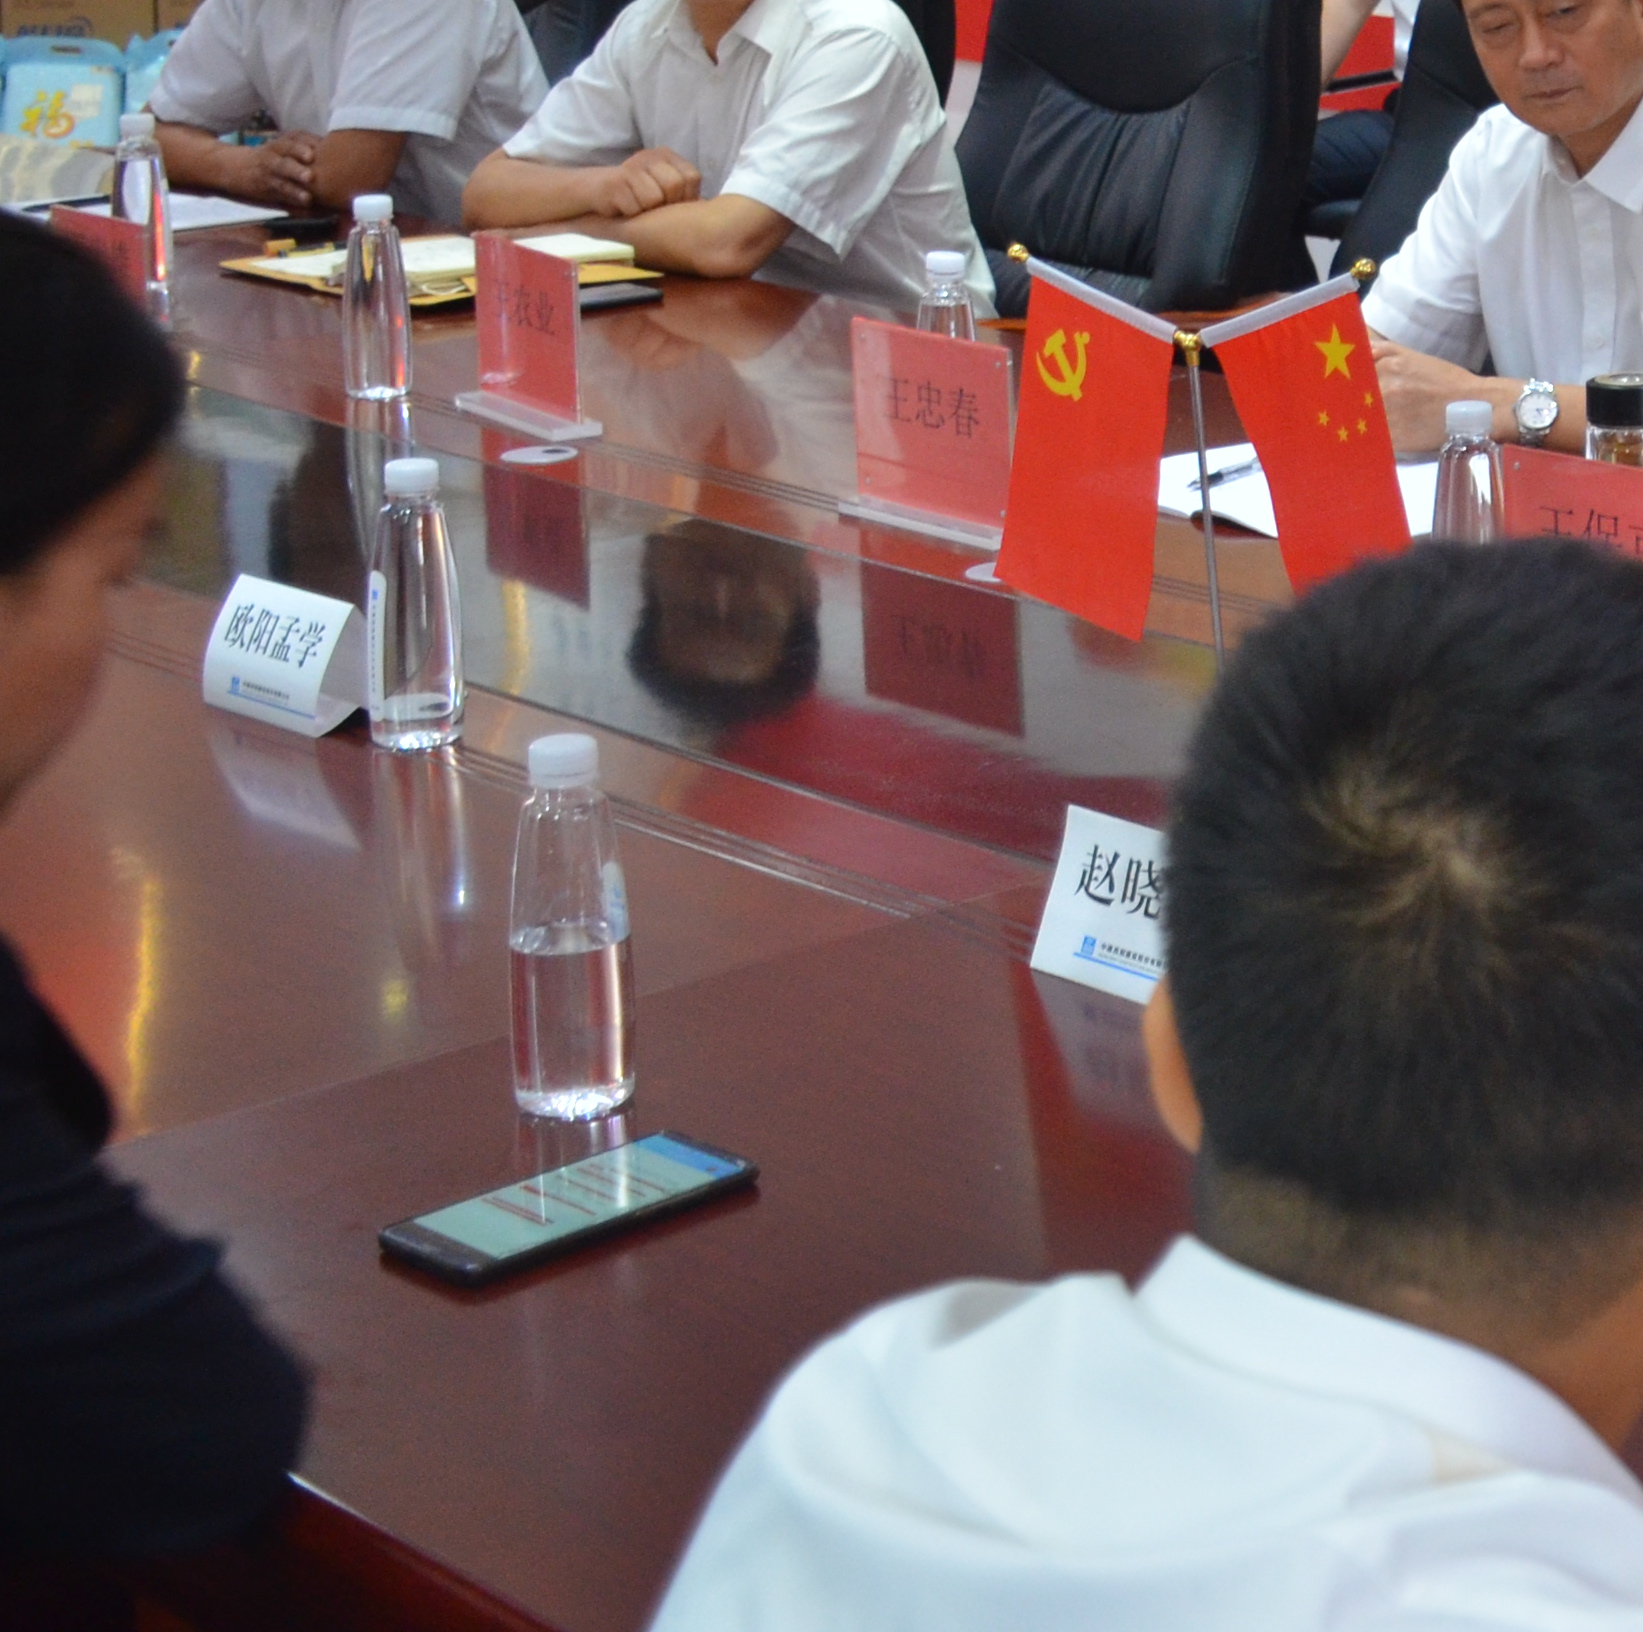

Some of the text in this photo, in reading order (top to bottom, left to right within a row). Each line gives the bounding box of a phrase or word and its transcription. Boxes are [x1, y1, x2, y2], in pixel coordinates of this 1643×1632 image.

[883, 373, 981, 441] 王忠春
[224, 603, 326, 669] 欧阳孟学
